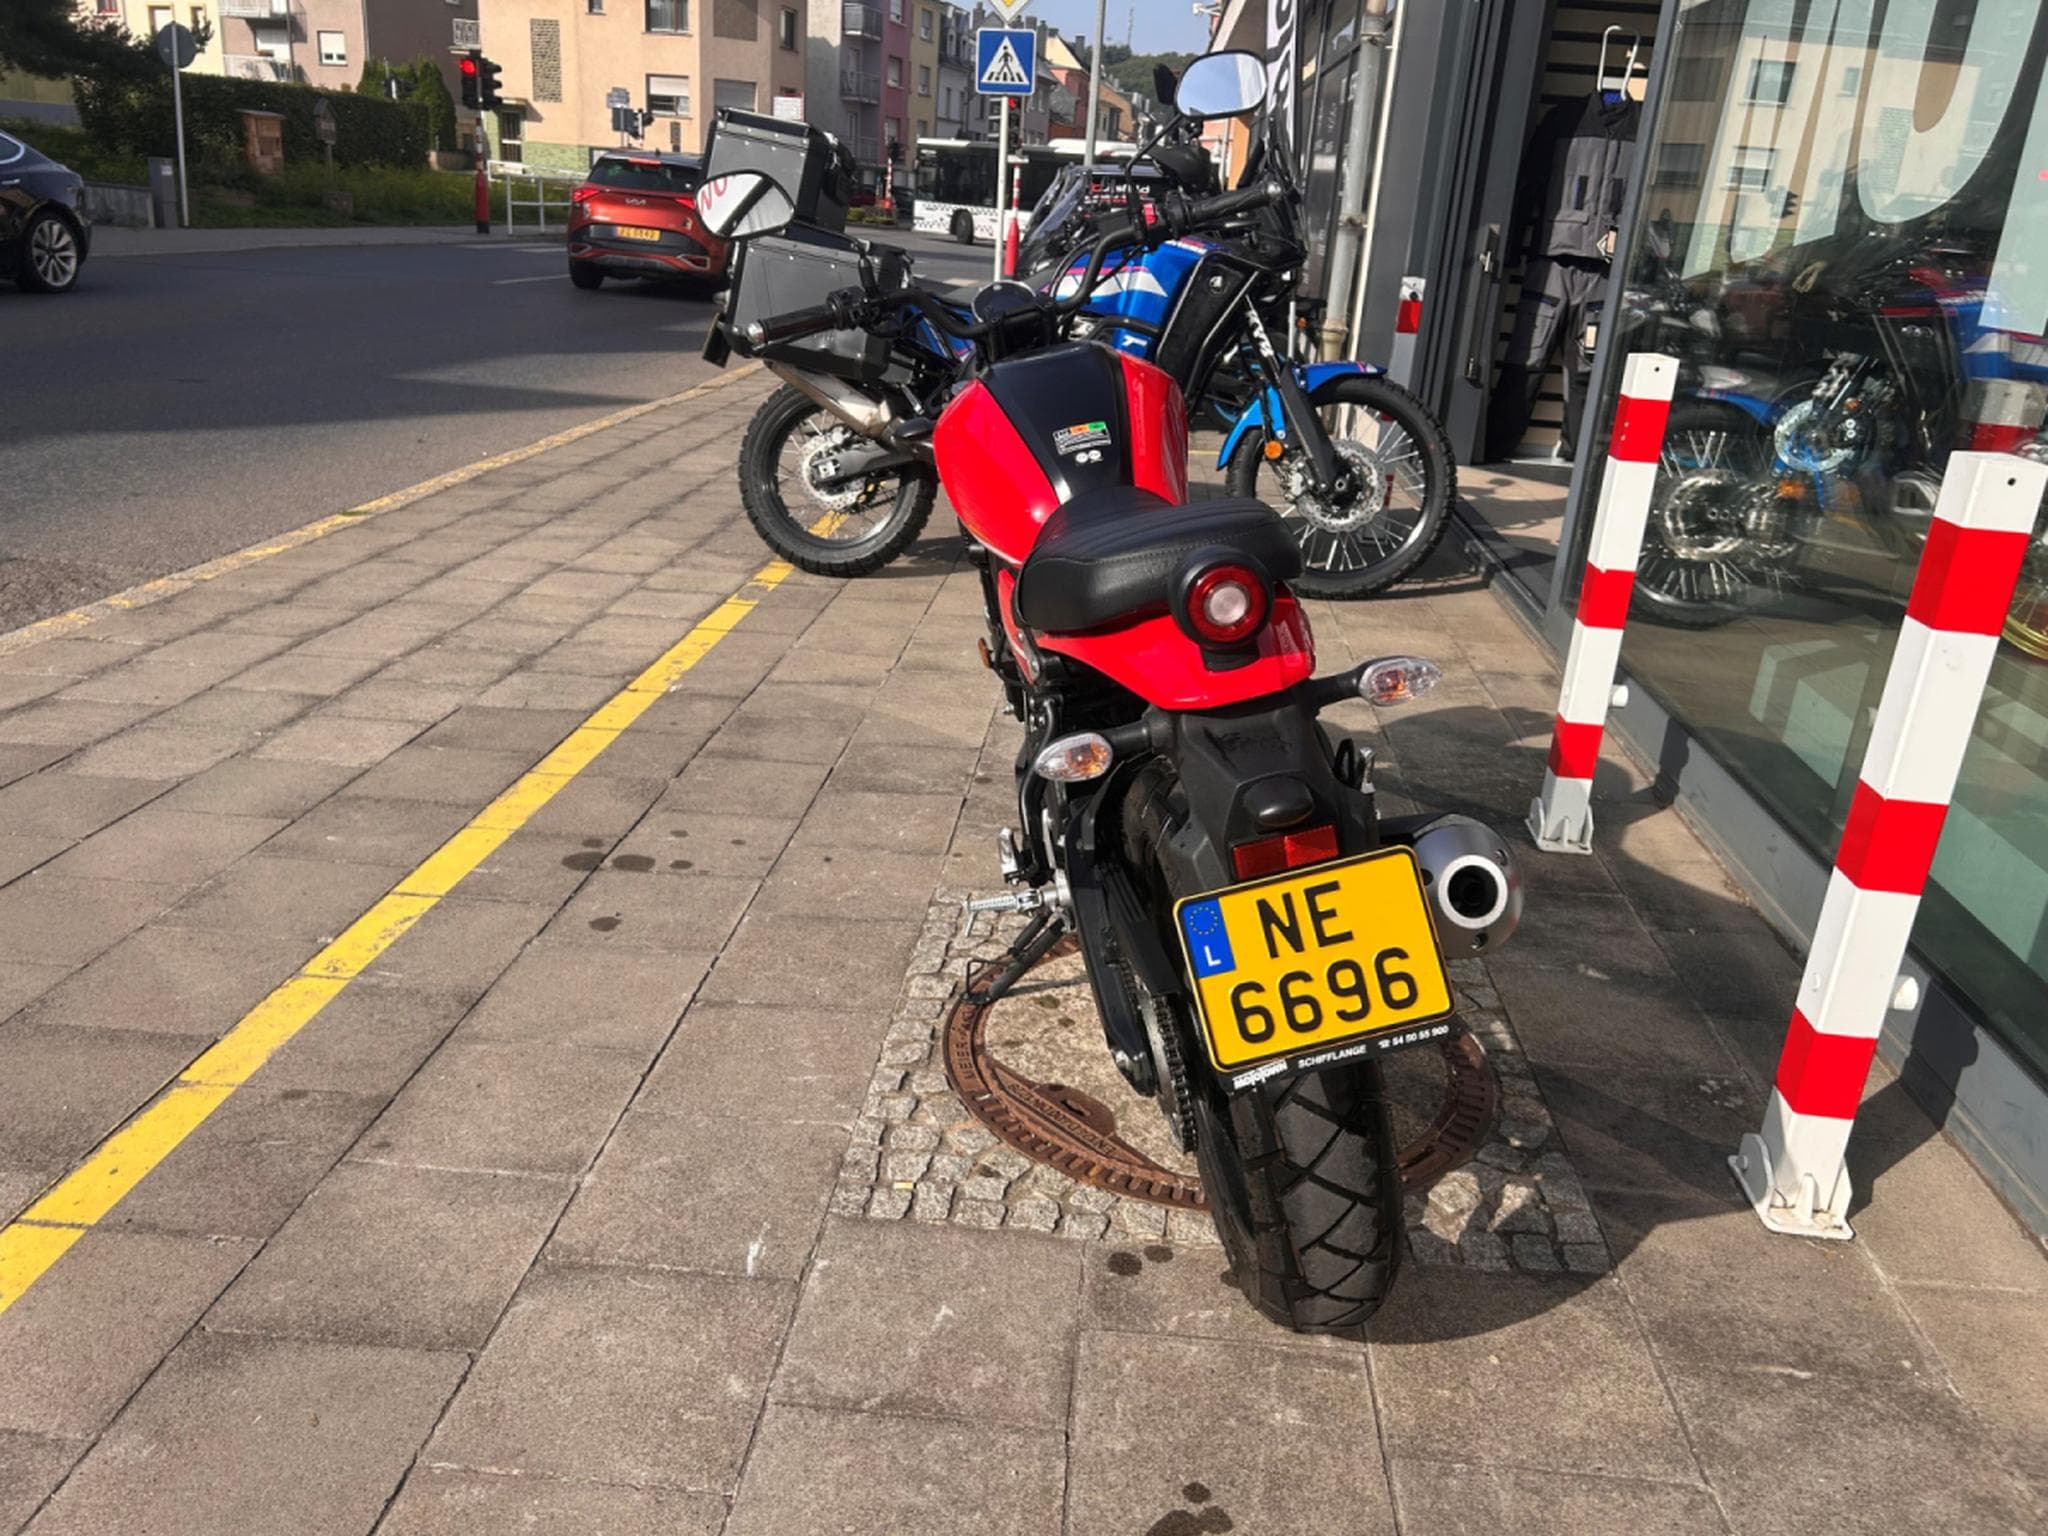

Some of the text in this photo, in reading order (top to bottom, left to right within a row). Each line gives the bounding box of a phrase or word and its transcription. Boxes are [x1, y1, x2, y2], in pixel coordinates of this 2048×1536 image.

[1256, 881, 1354, 958] NE
[1203, 944, 1222, 968] L
[1230, 946, 1418, 1045] 6696
[1298, 1044, 1366, 1068] SCHIFFLANGE
